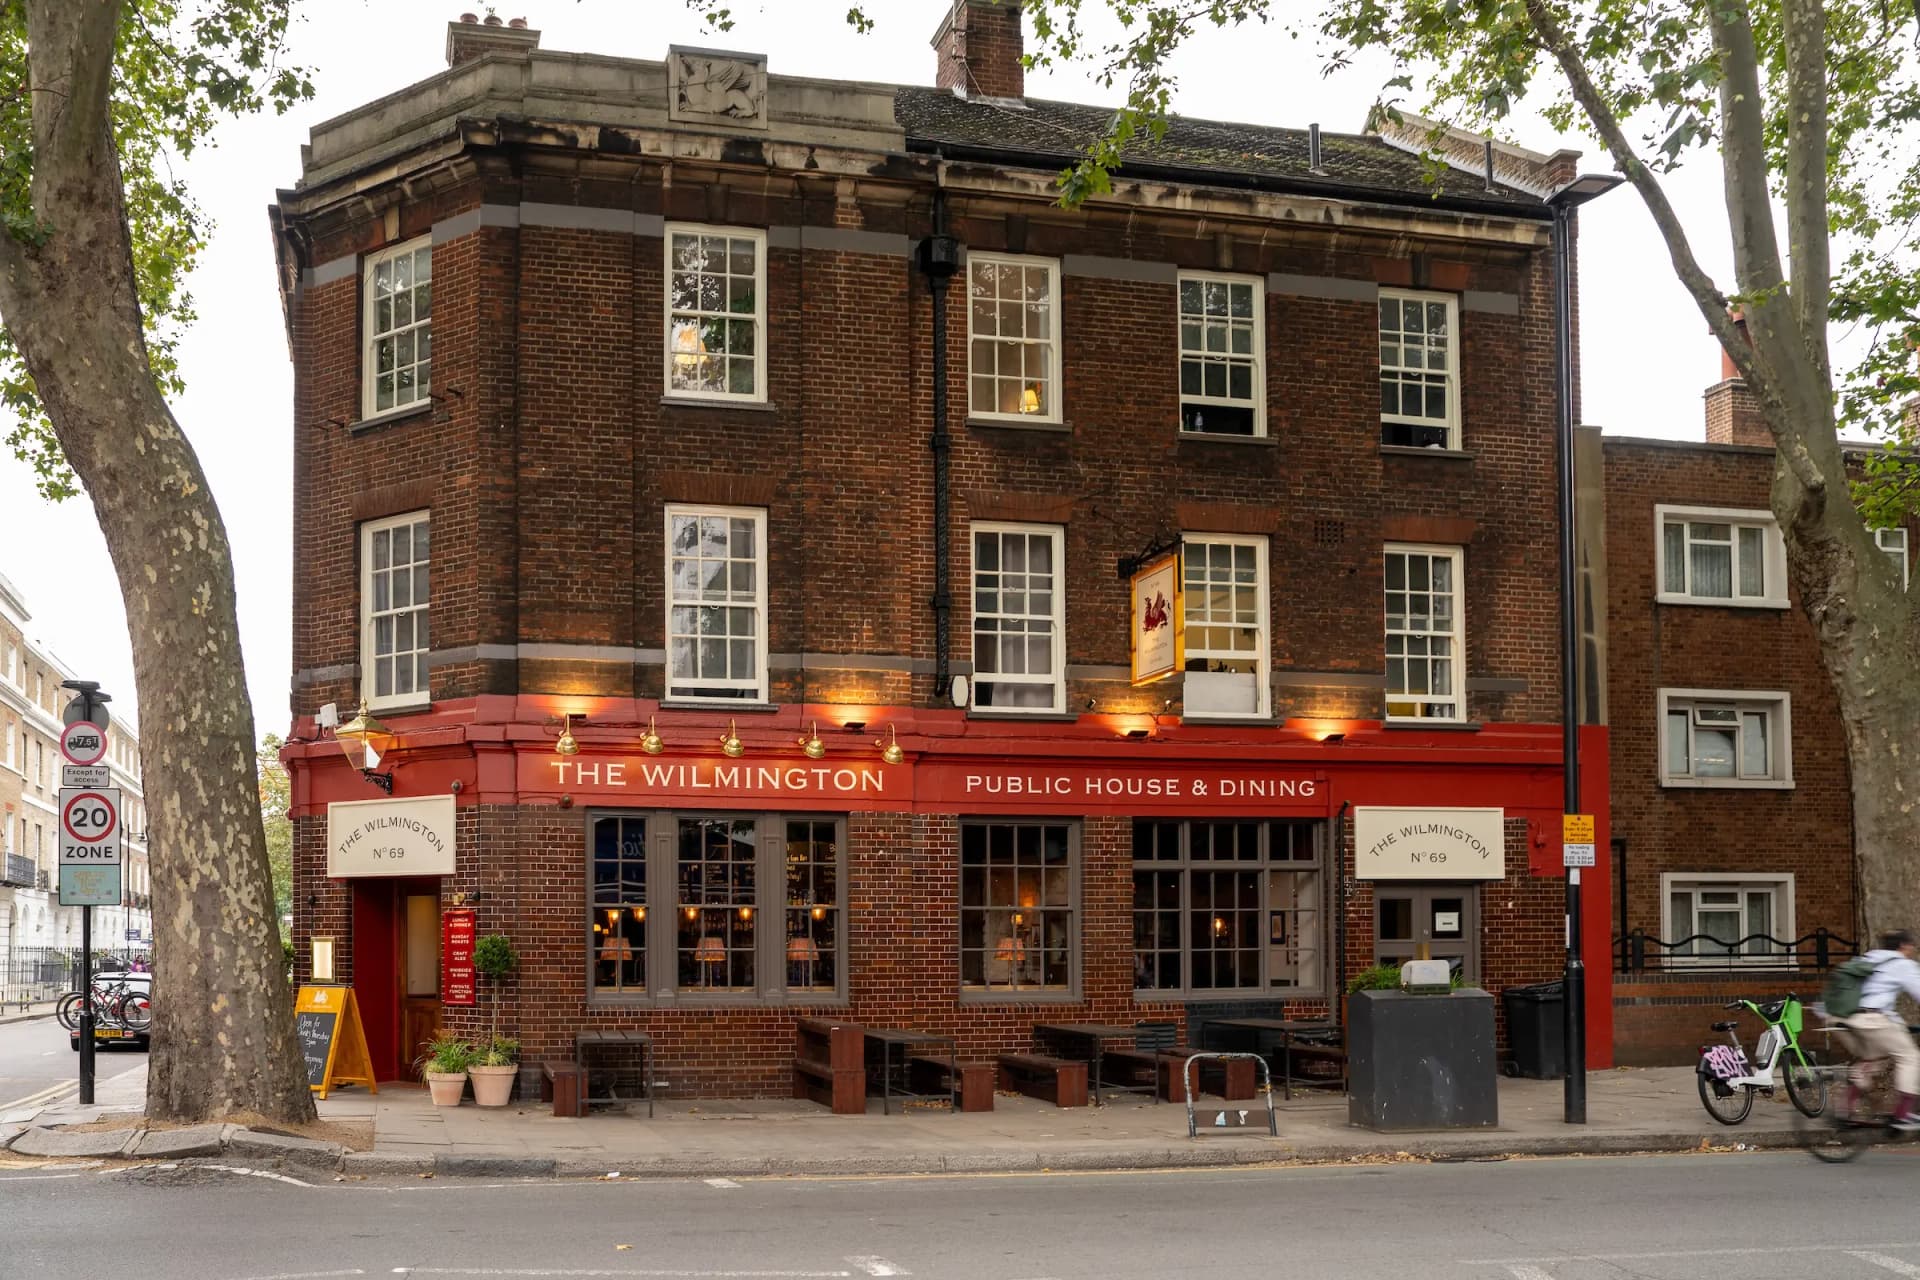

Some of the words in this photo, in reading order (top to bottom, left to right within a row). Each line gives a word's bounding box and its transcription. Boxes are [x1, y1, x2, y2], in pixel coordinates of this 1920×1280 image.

[67, 769, 93, 777] Except
[551, 762, 626, 786] THE
[641, 764, 884, 792] WILMINGTON
[966, 775, 1072, 794] PUBLIC
[1085, 777, 1180, 796] HOUSE
[1191, 779, 1208, 796] &
[1220, 779, 1316, 797] DINING
[72, 807, 108, 828] 20
[339, 828, 363, 855] THE
[364, 816, 445, 853] WILMINGTON
[1369, 832, 1397, 858] THE
[1399, 823, 1490, 860] WILMINGTON
[65, 845, 113, 859] ZONE
[390, 847, 405, 859] 69
[1429, 852, 1447, 863] 69
